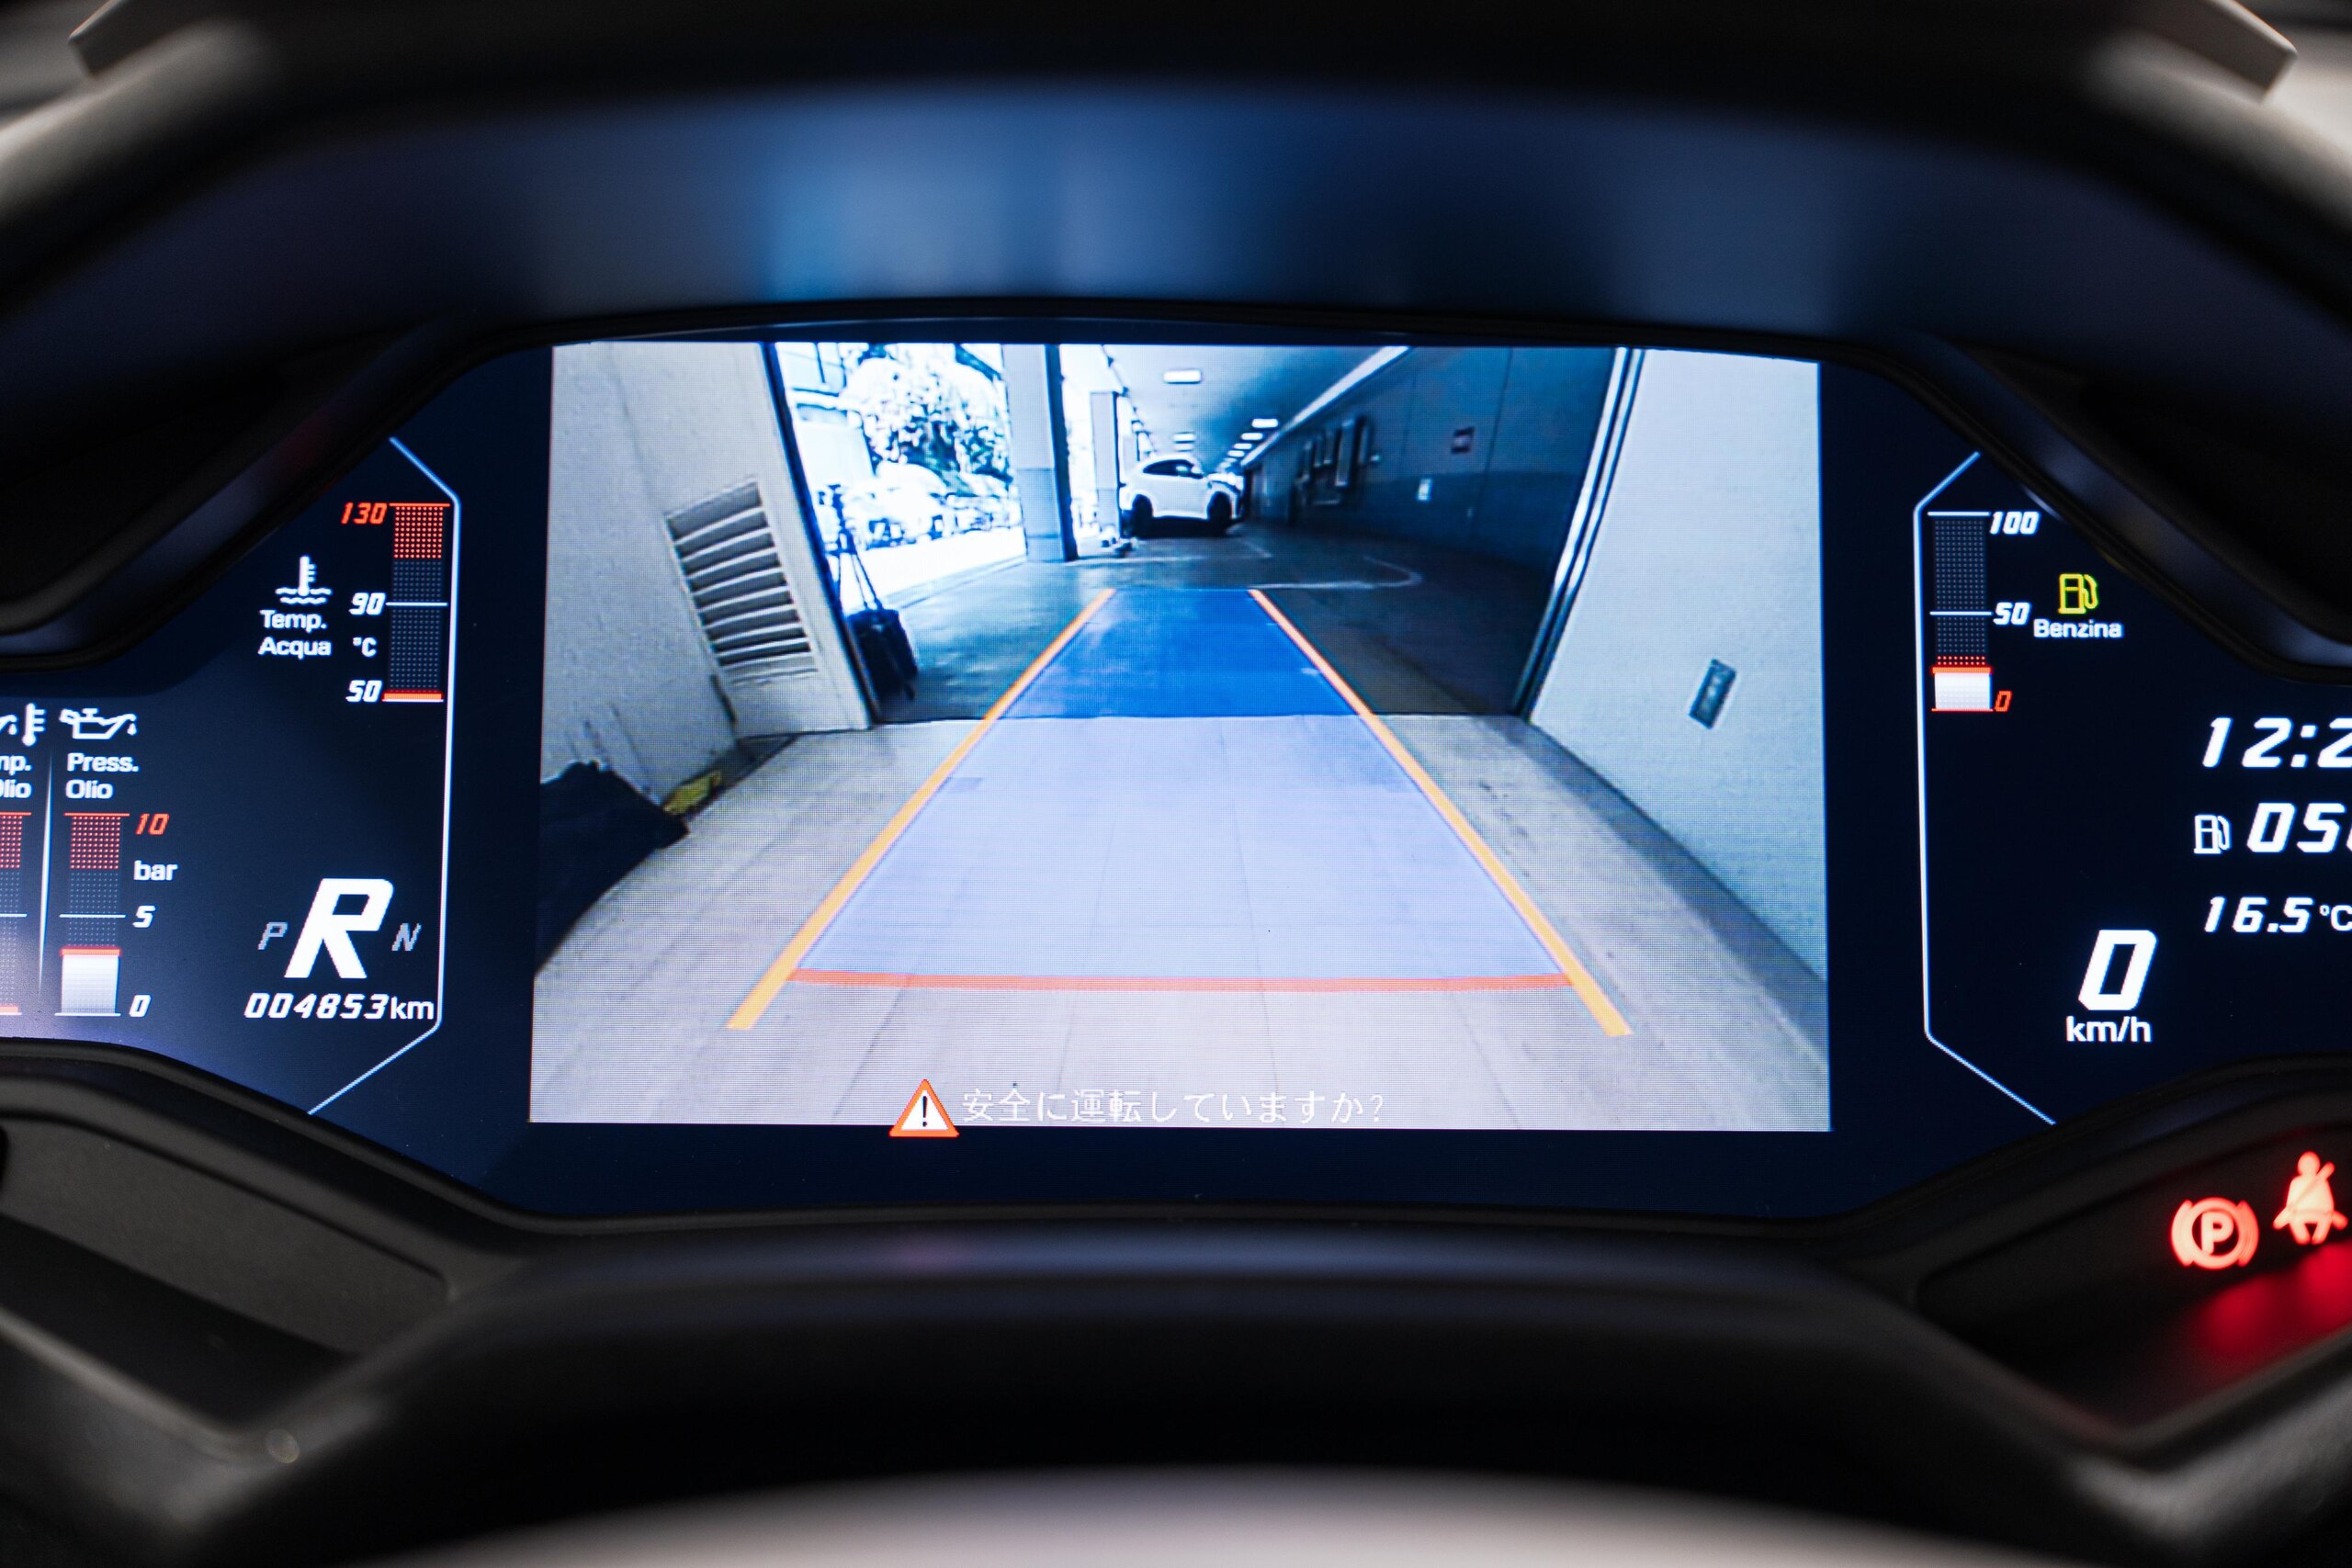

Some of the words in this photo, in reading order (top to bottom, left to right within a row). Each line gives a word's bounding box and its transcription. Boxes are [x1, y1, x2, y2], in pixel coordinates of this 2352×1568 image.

[340, 501, 388, 525] 130
[1989, 511, 2041, 536] 100
[348, 592, 386, 616] 90
[1993, 602, 2031, 626] 50
[259, 609, 328, 634] Temp.
[2032, 618, 2125, 638] Benzina
[257, 636, 333, 660] Acqua
[351, 637, 378, 658] °C
[345, 679, 382, 703] 50
[1993, 690, 2013, 713] 0
[66, 751, 140, 773] Press.
[0, 778, 33, 799] lio
[64, 778, 114, 800] Olio
[135, 812, 171, 837] 10
[2245, 802, 2352, 853] 05
[132, 860, 178, 882] bar
[132, 905, 156, 929] 5
[283, 877, 395, 980] R
[257, 921, 289, 952] P
[390, 922, 423, 953] N
[2076, 929, 2159, 1011] 0
[129, 994, 153, 1019] 0
[2065, 1015, 2154, 1043] km/h
